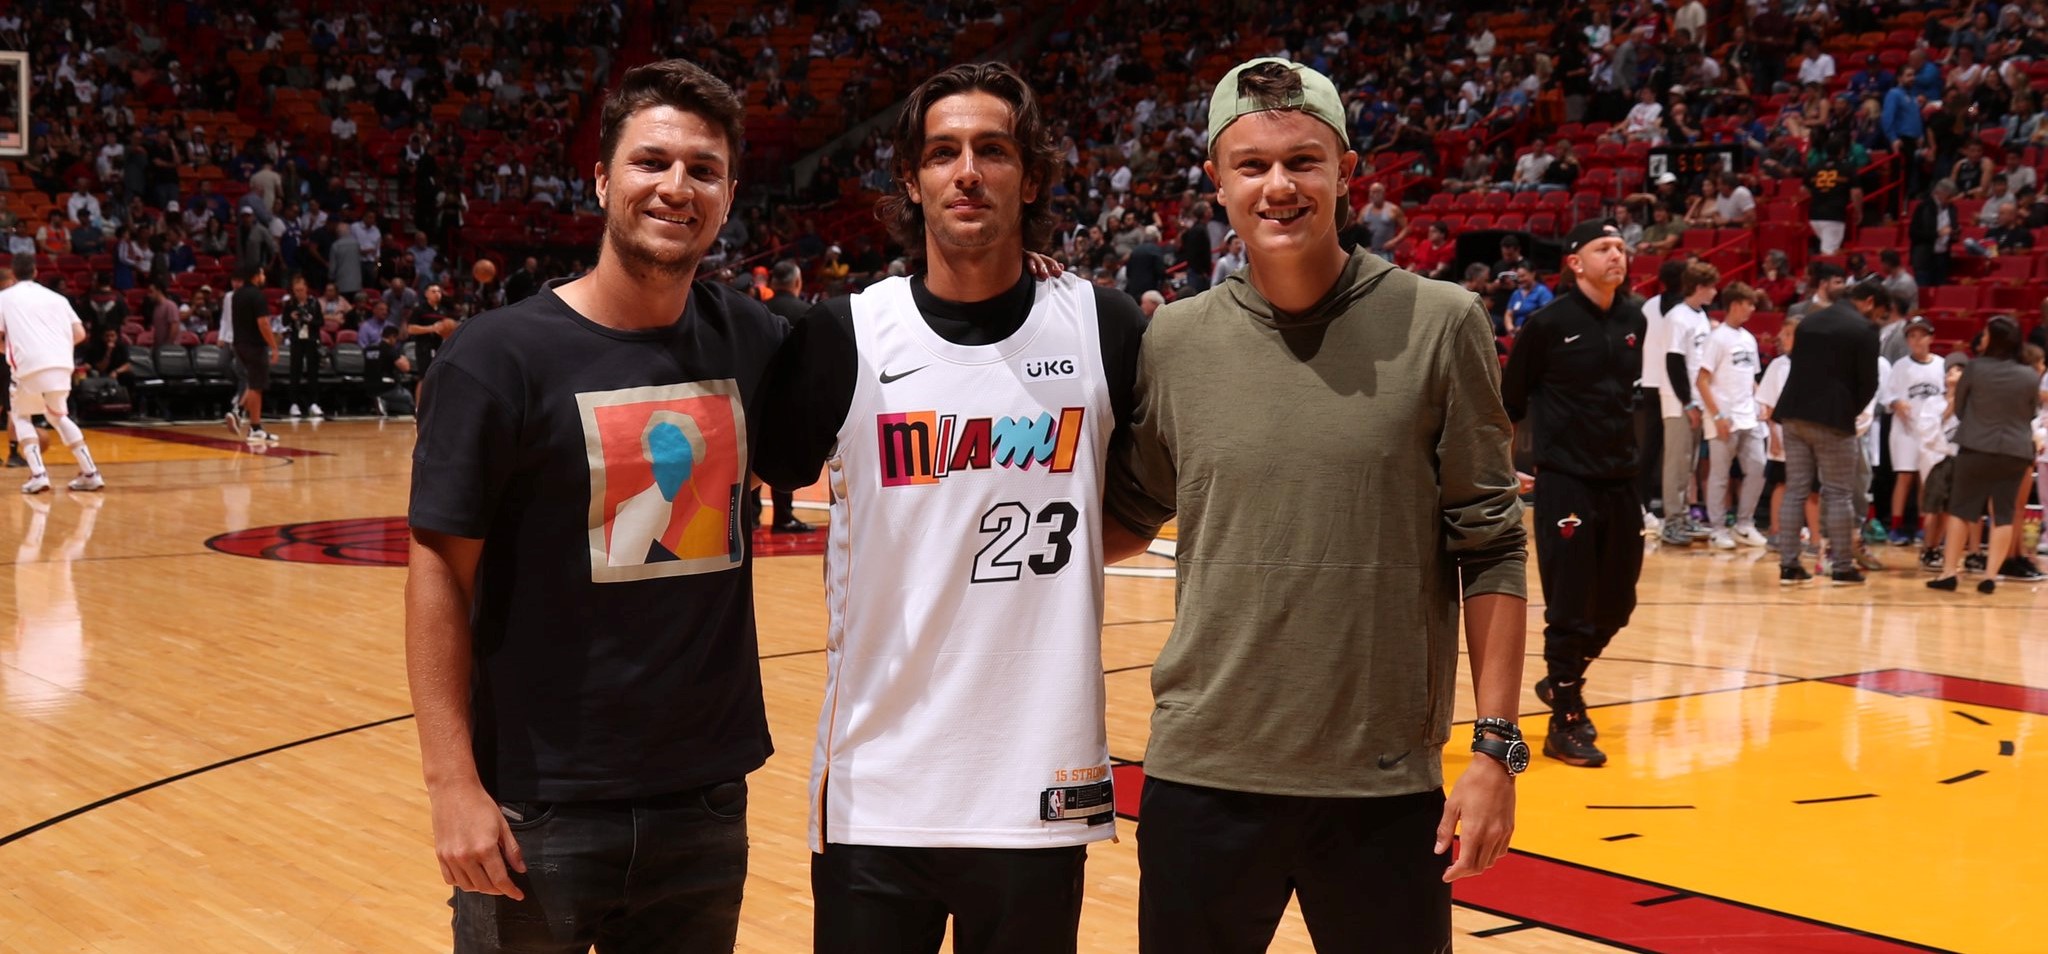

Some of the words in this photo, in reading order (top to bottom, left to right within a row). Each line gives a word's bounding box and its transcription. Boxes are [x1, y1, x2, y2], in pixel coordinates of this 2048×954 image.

[1815, 169, 1839, 188] 22
[970, 501, 1079, 584] 23
[1055, 769, 1067, 782] 15
